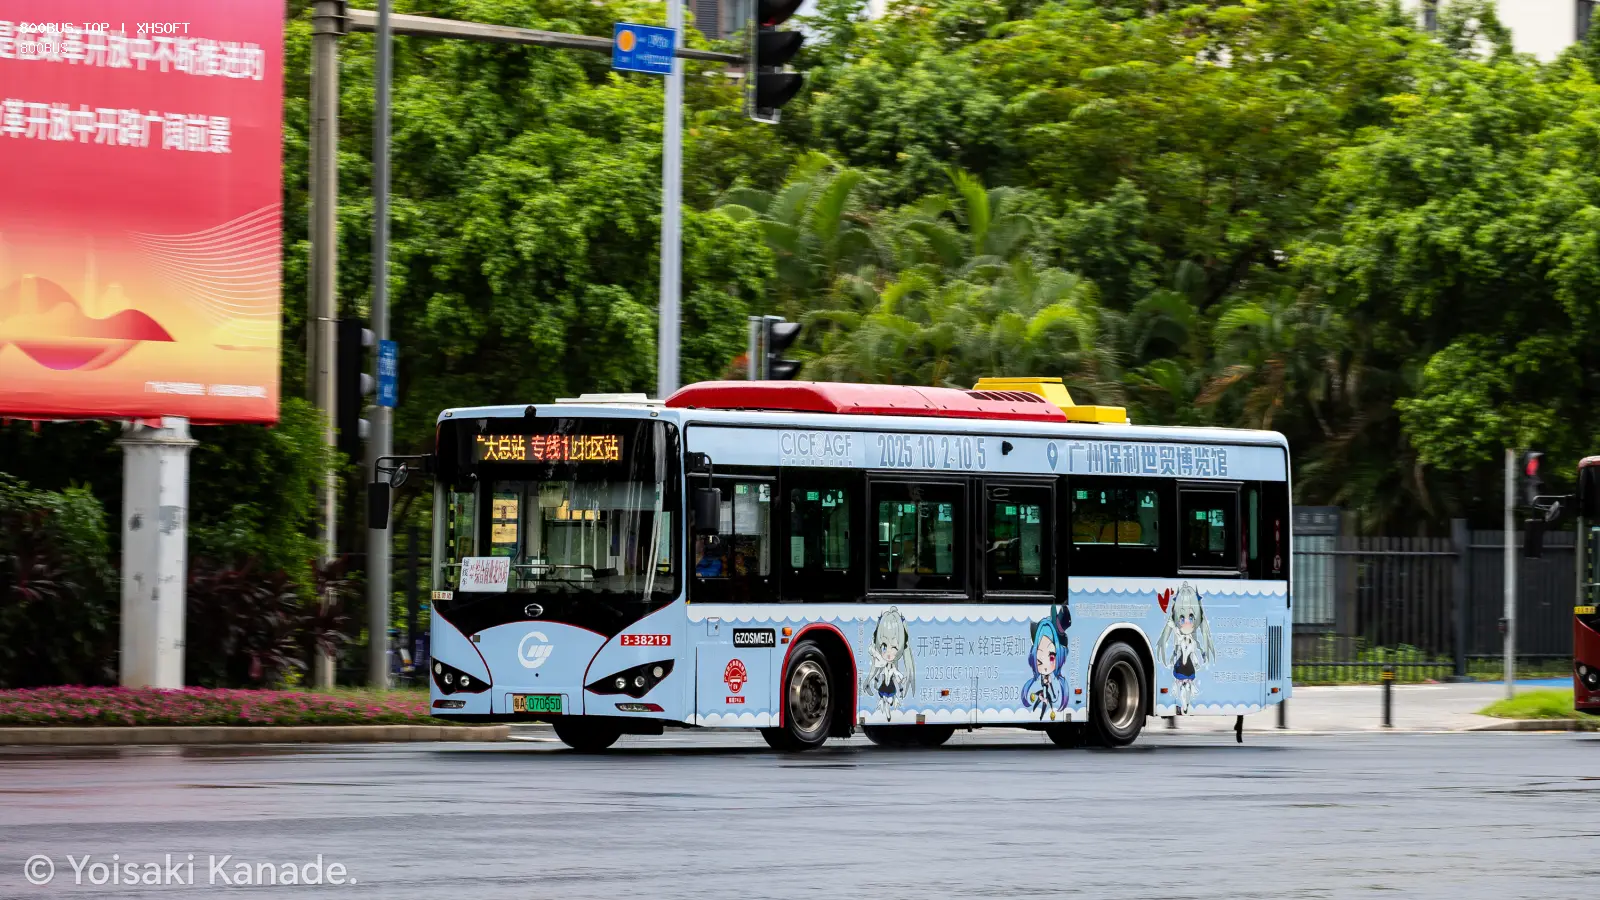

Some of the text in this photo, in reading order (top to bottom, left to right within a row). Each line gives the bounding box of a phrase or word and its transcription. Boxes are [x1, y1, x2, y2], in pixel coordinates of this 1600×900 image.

[0, 97, 232, 154] 革开放中开辟广阔前景
[1068, 441, 1228, 477] 广州保利世贸博览馆
[623, 635, 668, 646] 3-38219
[734, 632, 774, 645] GZOSMETA
[917, 634, 965, 657] 开源宇宙
[925, 666, 944, 680] 2025
